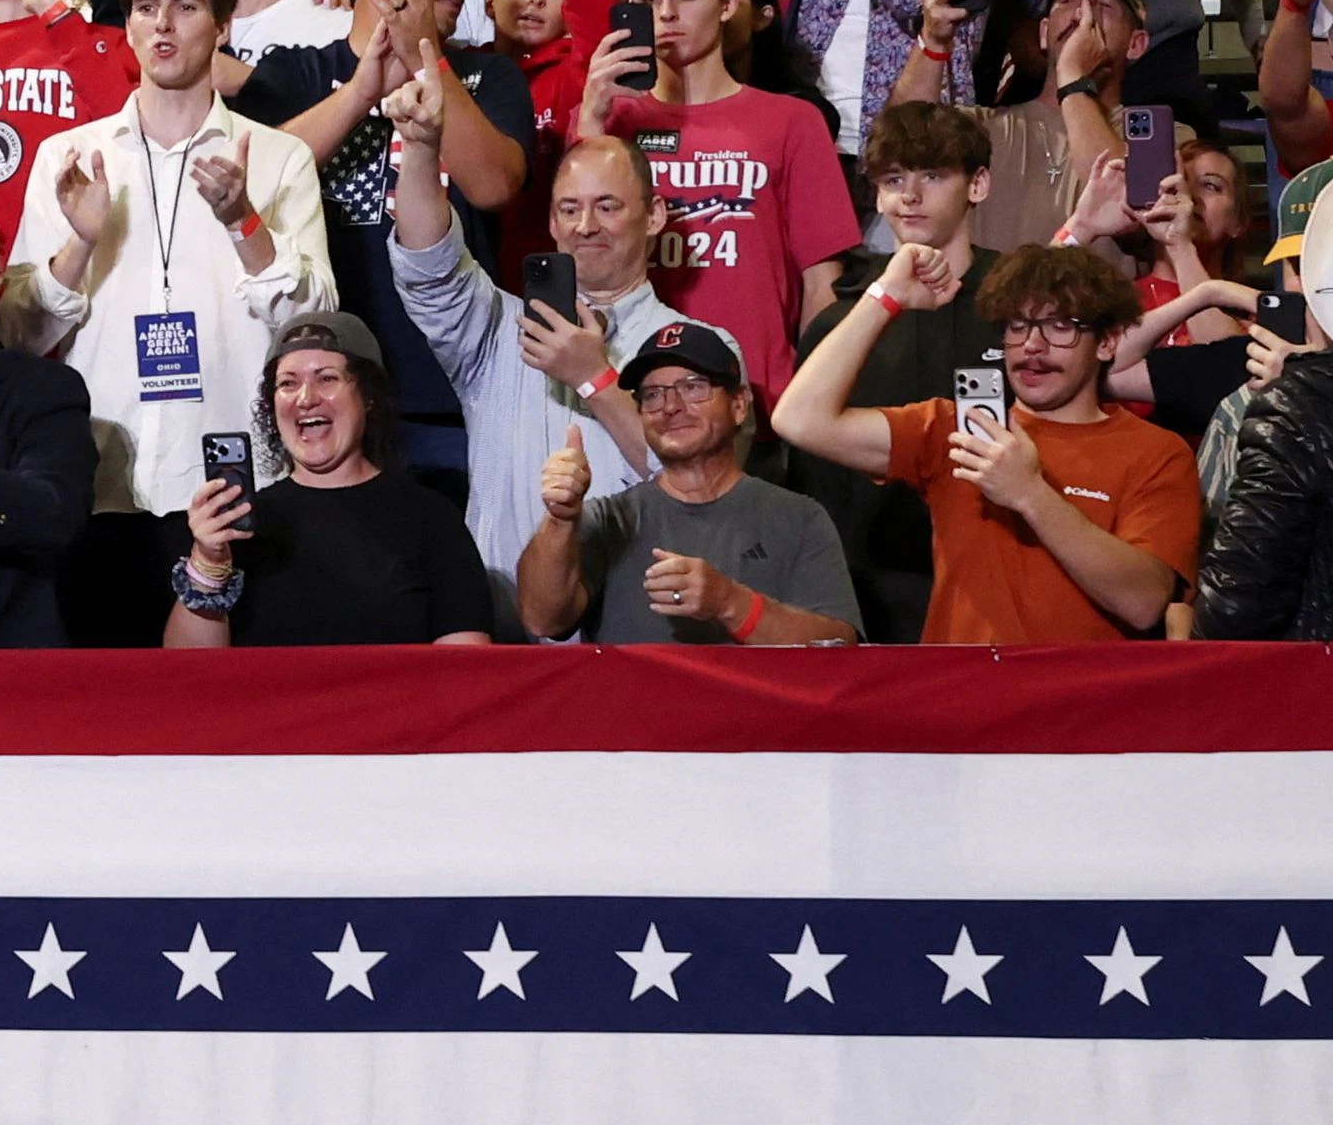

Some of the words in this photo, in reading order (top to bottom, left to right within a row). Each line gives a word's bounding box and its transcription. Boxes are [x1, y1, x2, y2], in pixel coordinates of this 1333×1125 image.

[636, 134, 676, 146] FABER
[693, 150, 749, 162] President
[649, 158, 769, 200] rump
[149, 321, 184, 332] MAKE
[139, 328, 195, 341] AMERICA
[656, 325, 685, 349] C
[147, 338, 188, 349] GREAT
[146, 345, 190, 357] AGAIN!
[156, 363, 181, 372] OHIO
[141, 377, 199, 390] VOLUNTEER
